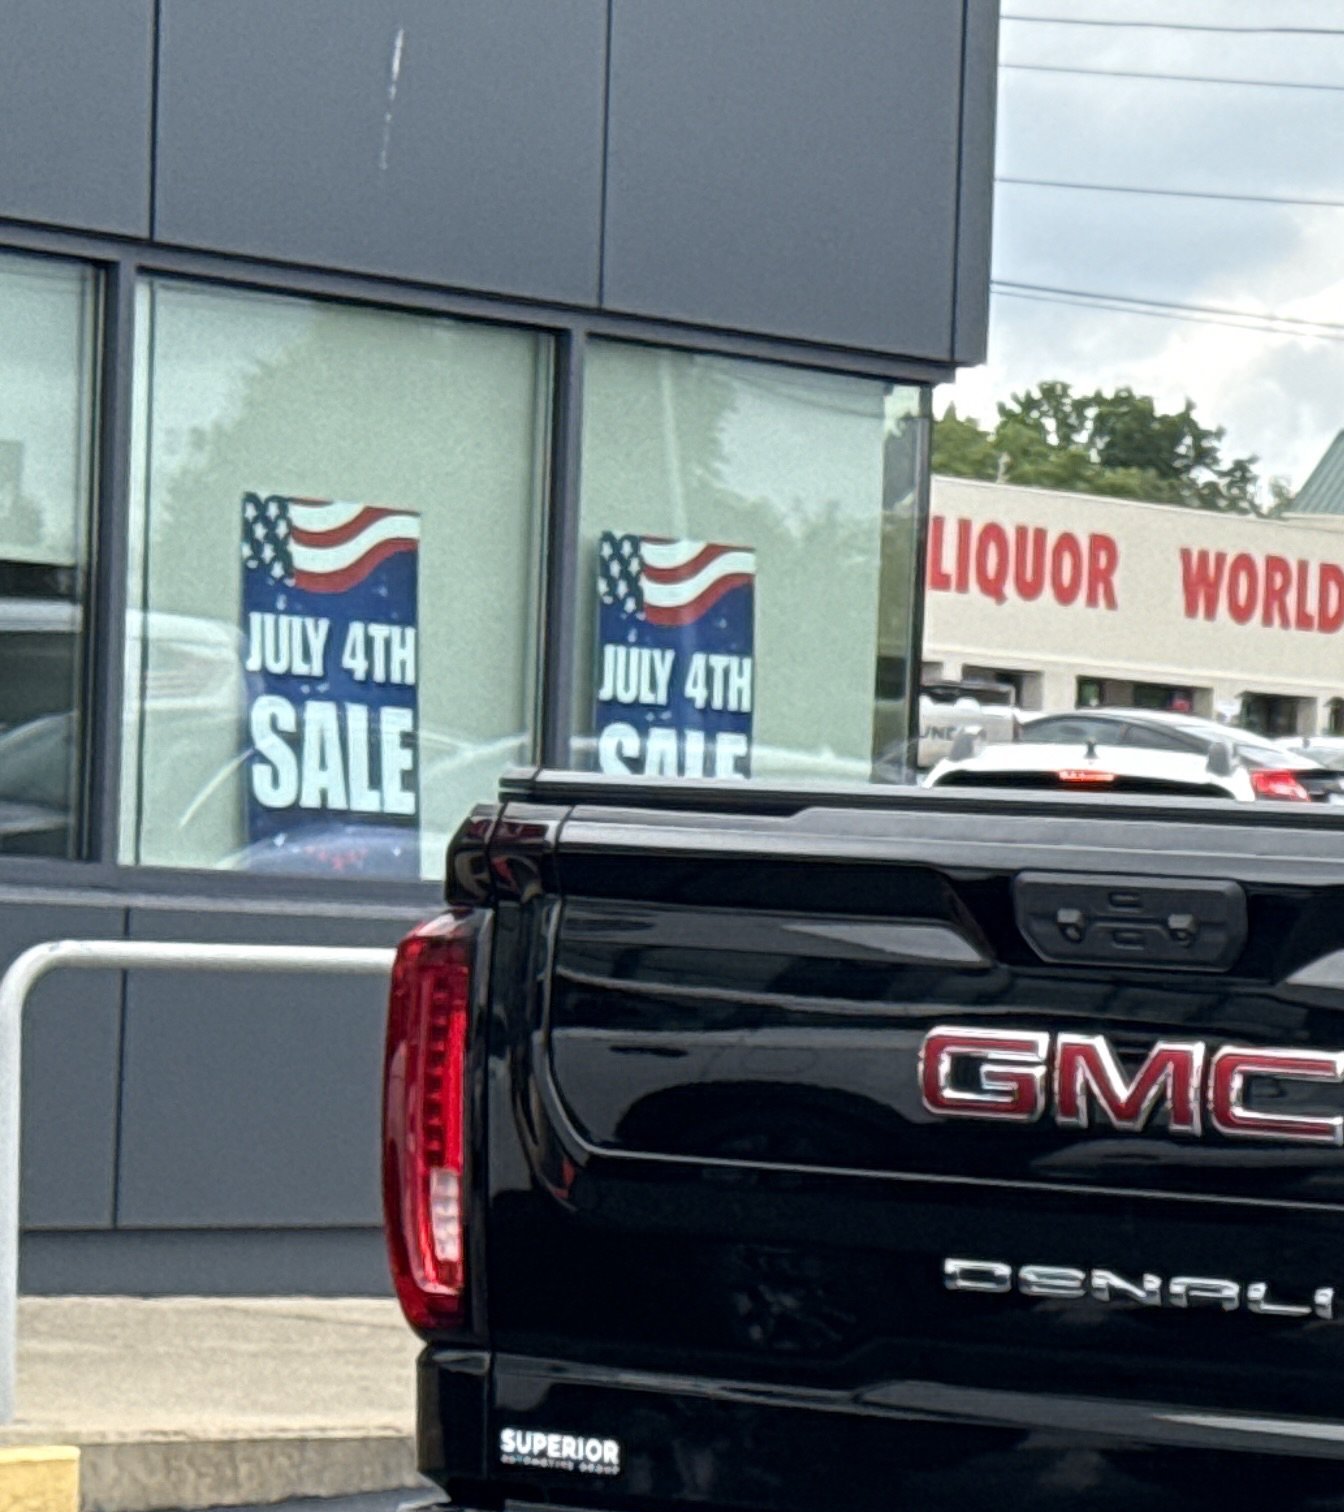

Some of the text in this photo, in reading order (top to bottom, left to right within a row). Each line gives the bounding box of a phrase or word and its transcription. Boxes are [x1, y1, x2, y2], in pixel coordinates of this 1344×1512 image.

[928, 515, 1118, 610] LIQUOR
[246, 611, 415, 685] JULY 4TH
[599, 643, 752, 712] JULY 4TH
[250, 694, 415, 815] SALE
[944, 1258, 1334, 1320] DENALI
[500, 1427, 620, 1465] SUPERIOR
